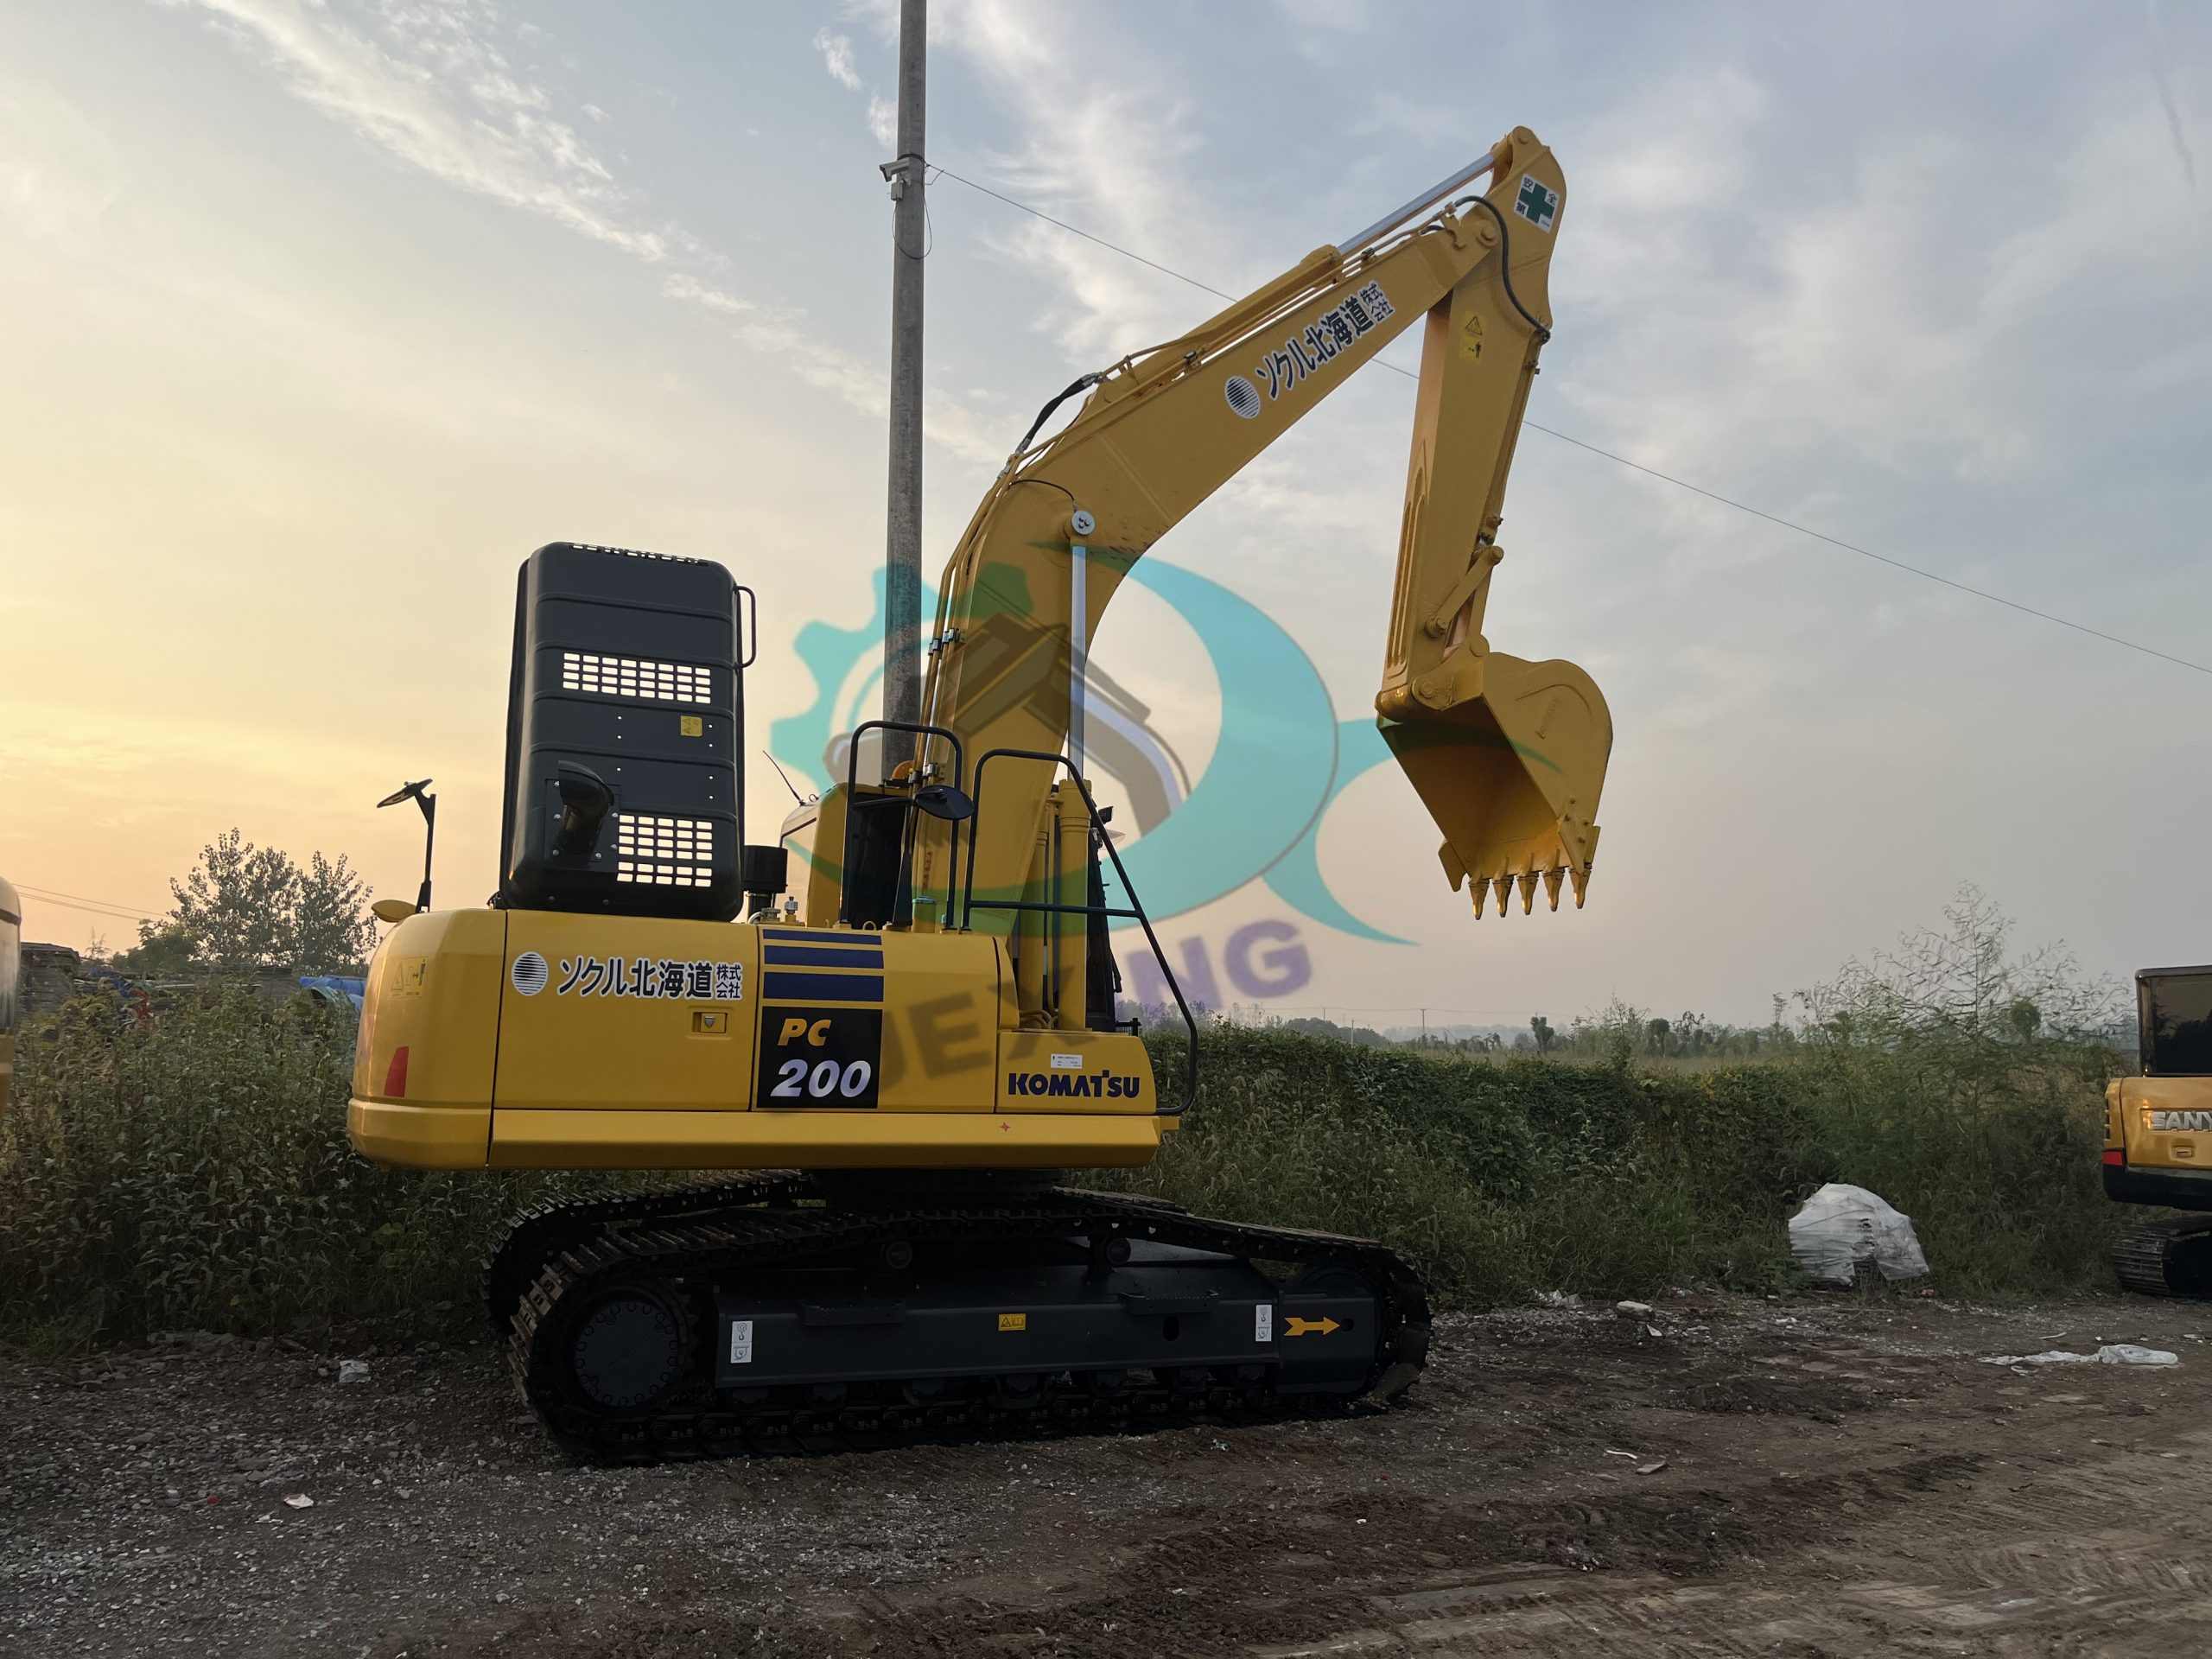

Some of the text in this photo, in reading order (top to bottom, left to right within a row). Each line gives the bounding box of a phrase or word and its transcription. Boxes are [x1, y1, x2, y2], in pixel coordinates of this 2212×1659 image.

[777, 1018, 832, 1046] PC
[770, 1058, 872, 1098] 200
[1008, 1070, 1141, 1099] KOMATSU
